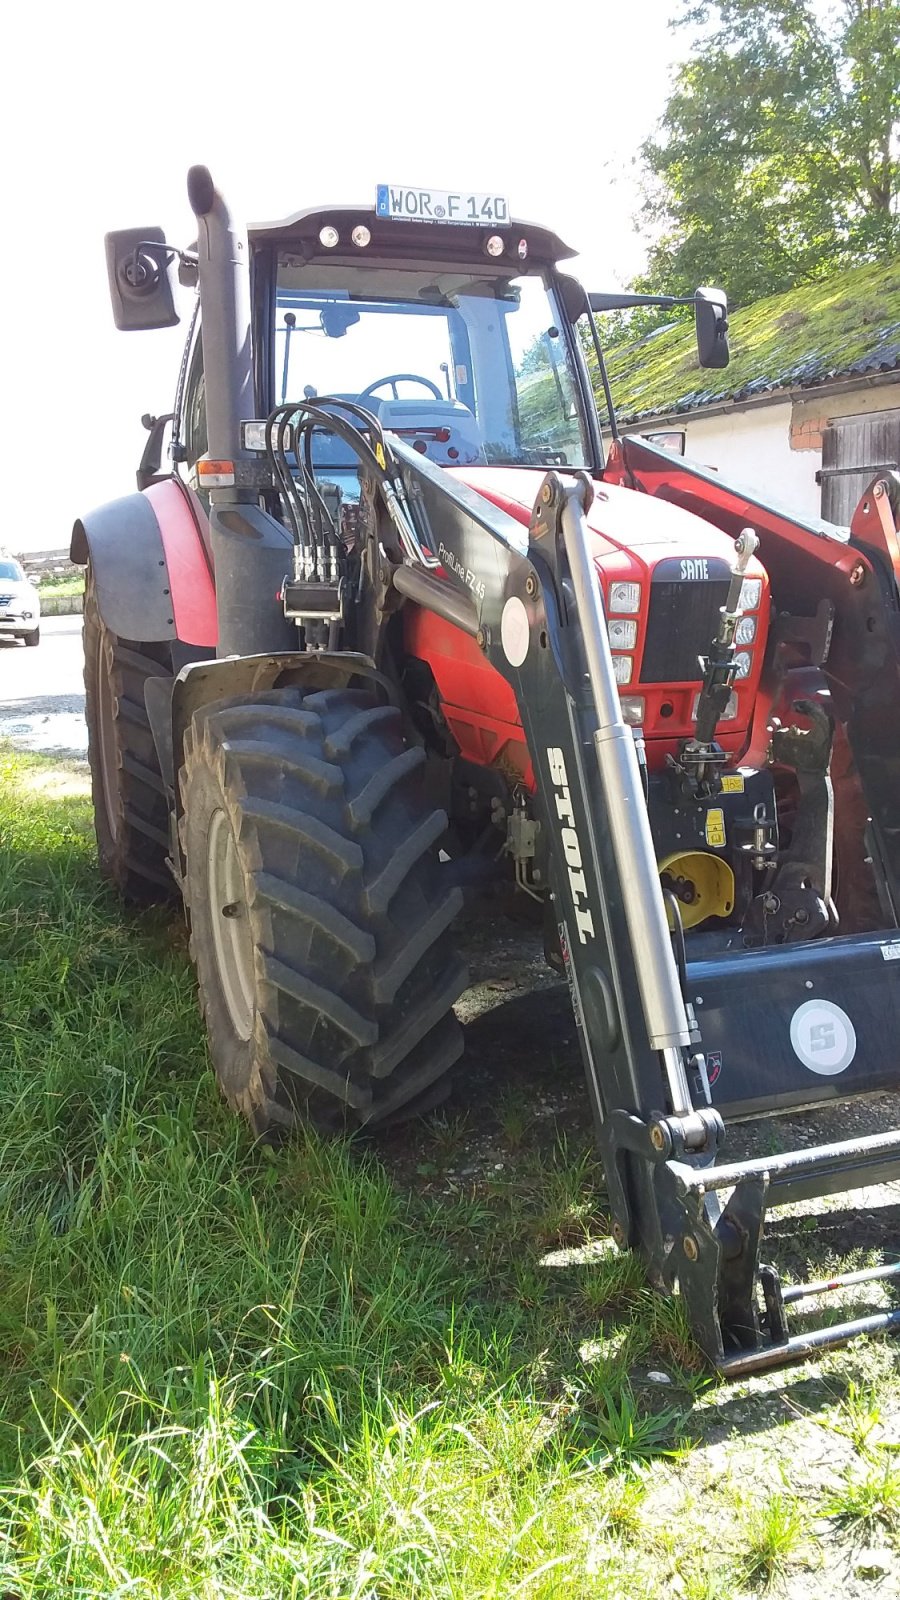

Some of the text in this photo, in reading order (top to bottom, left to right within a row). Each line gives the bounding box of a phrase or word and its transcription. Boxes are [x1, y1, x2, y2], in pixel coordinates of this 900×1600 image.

[391, 189, 507, 220] WOR F 140
[680, 559, 709, 580] SAME
[546, 747, 595, 945] STOLL
